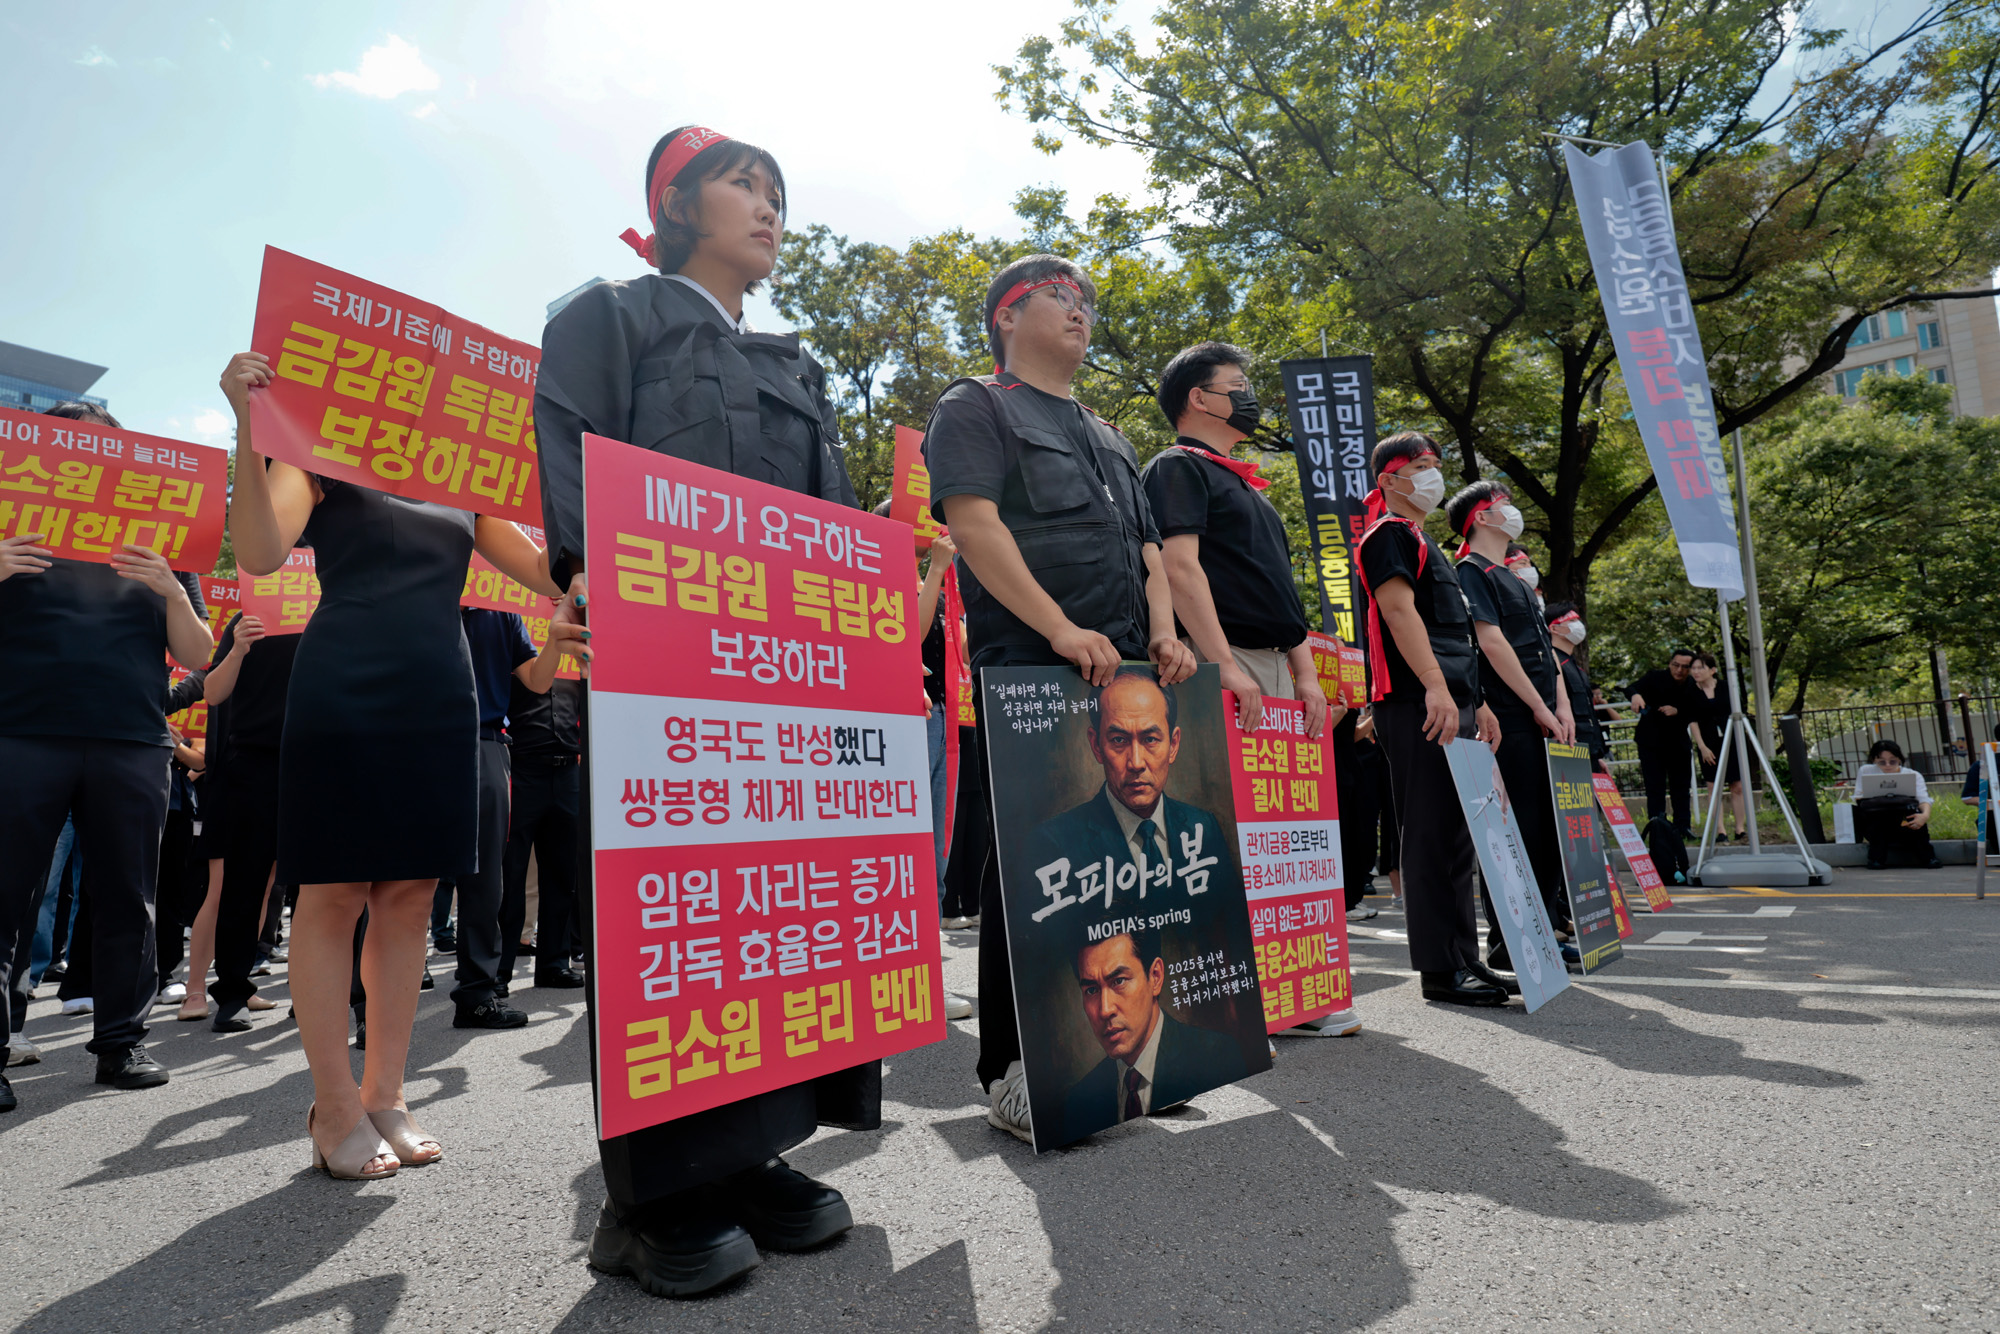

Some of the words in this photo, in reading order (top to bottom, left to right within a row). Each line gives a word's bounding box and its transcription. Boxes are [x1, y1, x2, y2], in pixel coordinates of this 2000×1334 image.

[313, 281, 452, 356] 국제기준에
[276, 321, 436, 417] 금감원
[50, 428, 124, 459] 자리만
[133, 442, 199, 472] 늘리는
[312, 406, 532, 507] 보장하라!
[1333, 371, 1368, 500] 국민경제
[0, 453, 104, 503] 소원
[113, 469, 204, 518] 분리
[1297, 373, 1336, 501] 모피아의
[1317, 514, 1354, 642] 금융독재
[645, 474, 747, 544] IMF가
[760, 505, 881, 574] 요구하는
[615, 532, 768, 623] 금감원
[792, 569, 906, 644] 독립성
[710, 628, 847, 690] 보장하라
[1002, 700, 1043, 717] 성공하면
[1047, 699, 1066, 714] 자리
[1070, 698, 1099, 714] 늘리기
[1234, 703, 1293, 734] 소비자
[664, 716, 766, 764] 영국도
[777, 722, 886, 766] 반성했다
[1241, 737, 1289, 773] 금소원
[1295, 741, 1323, 775] 분리
[620, 778, 730, 828] 쌍봉형
[743, 778, 804, 823] 체계
[815, 779, 918, 820] 반대한다
[1252, 778, 1284, 812] 결사
[1290, 779, 1319, 812] 반대
[1555, 782, 1594, 810] 금융소비자
[1247, 829, 1329, 856] 관치금융으로부터
[637, 868, 721, 930] 임원
[735, 861, 840, 916] 자리는
[850, 854, 916, 905] 증가!
[1242, 861, 1296, 890] 금융소비자
[1298, 857, 1336, 883] 지켜내자
[1148, 908, 1192, 930] spring
[1252, 907, 1277, 937] 실익
[1278, 904, 1302, 932] 없는
[1303, 898, 1334, 927] 쪼개기
[639, 936, 723, 1001] 감독
[739, 919, 843, 981] 효율은
[854, 909, 919, 962] 감소!
[1254, 931, 1340, 981] 금융소비자는
[1263, 980, 1295, 1023] 눈물
[1302, 968, 1348, 1012] 흘린다!
[625, 998, 762, 1100] 금소원
[783, 979, 854, 1058] 분리
[870, 963, 932, 1034] 반대
